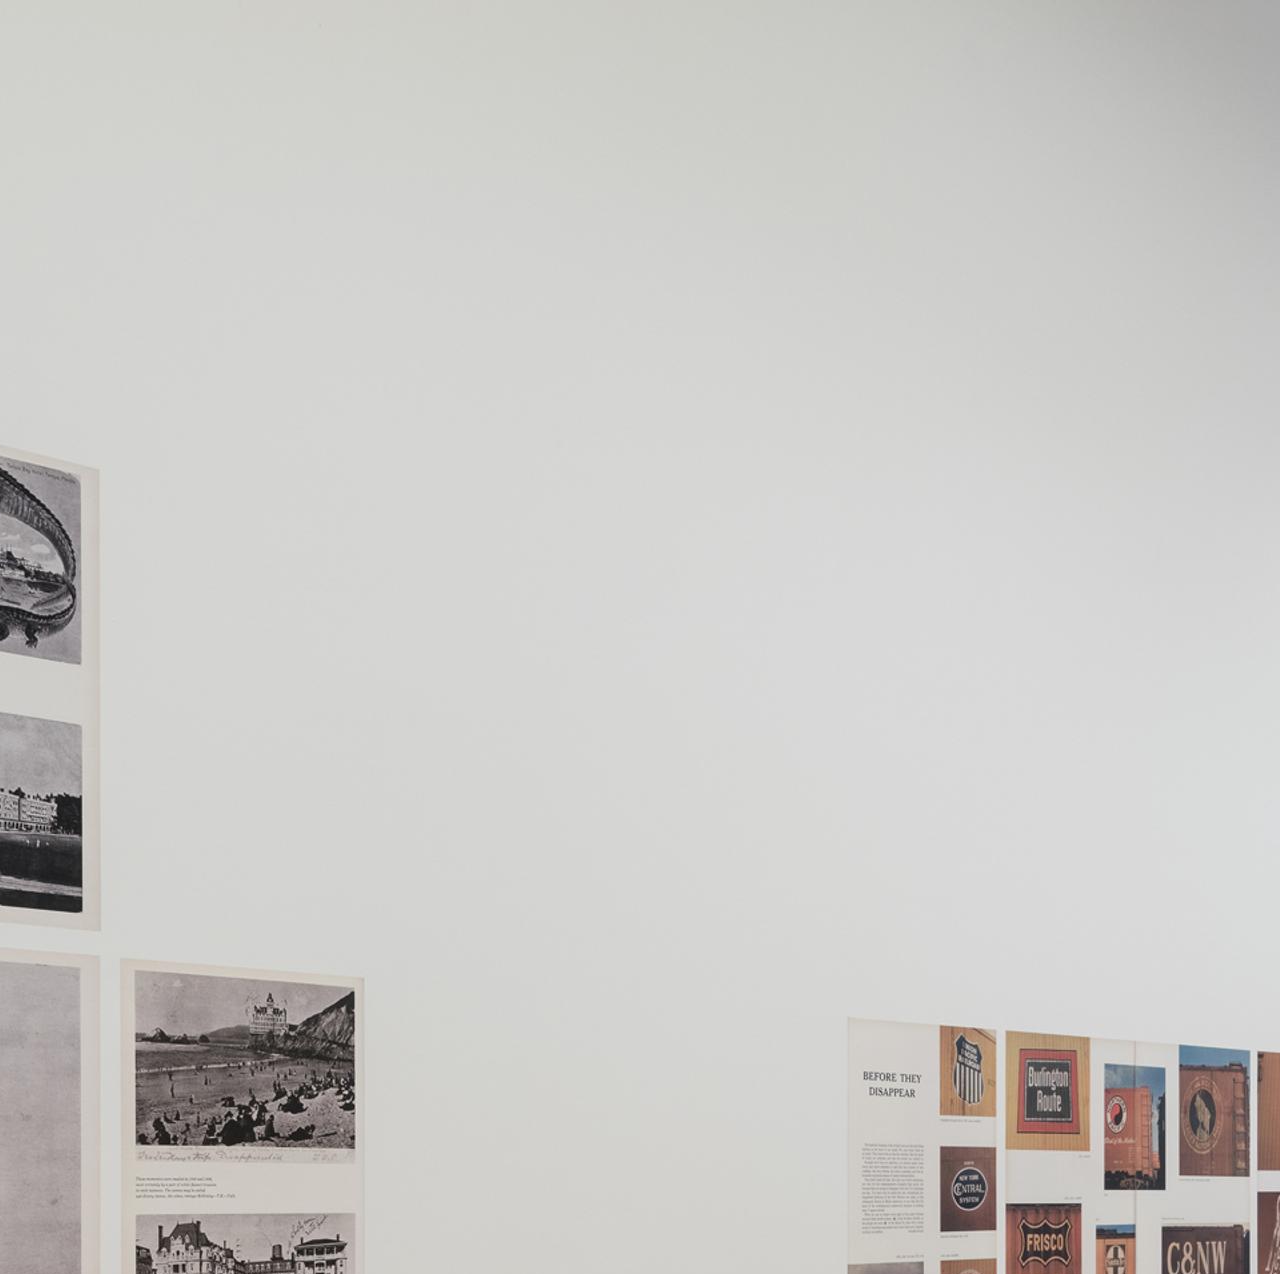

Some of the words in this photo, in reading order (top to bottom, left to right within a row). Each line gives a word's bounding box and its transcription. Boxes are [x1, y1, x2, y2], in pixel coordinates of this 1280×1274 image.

[863, 1071, 897, 1082] BEFORE
[900, 1073, 922, 1083] THEY
[1028, 1066, 1069, 1091] Burlington
[869, 1087, 916, 1098] DISAPPEAR
[1036, 1089, 1062, 1112] Route
[953, 1182, 985, 1196] CENTRAL
[959, 1196, 980, 1204] SYSTEM
[1026, 1233, 1064, 1252] FRISCO
